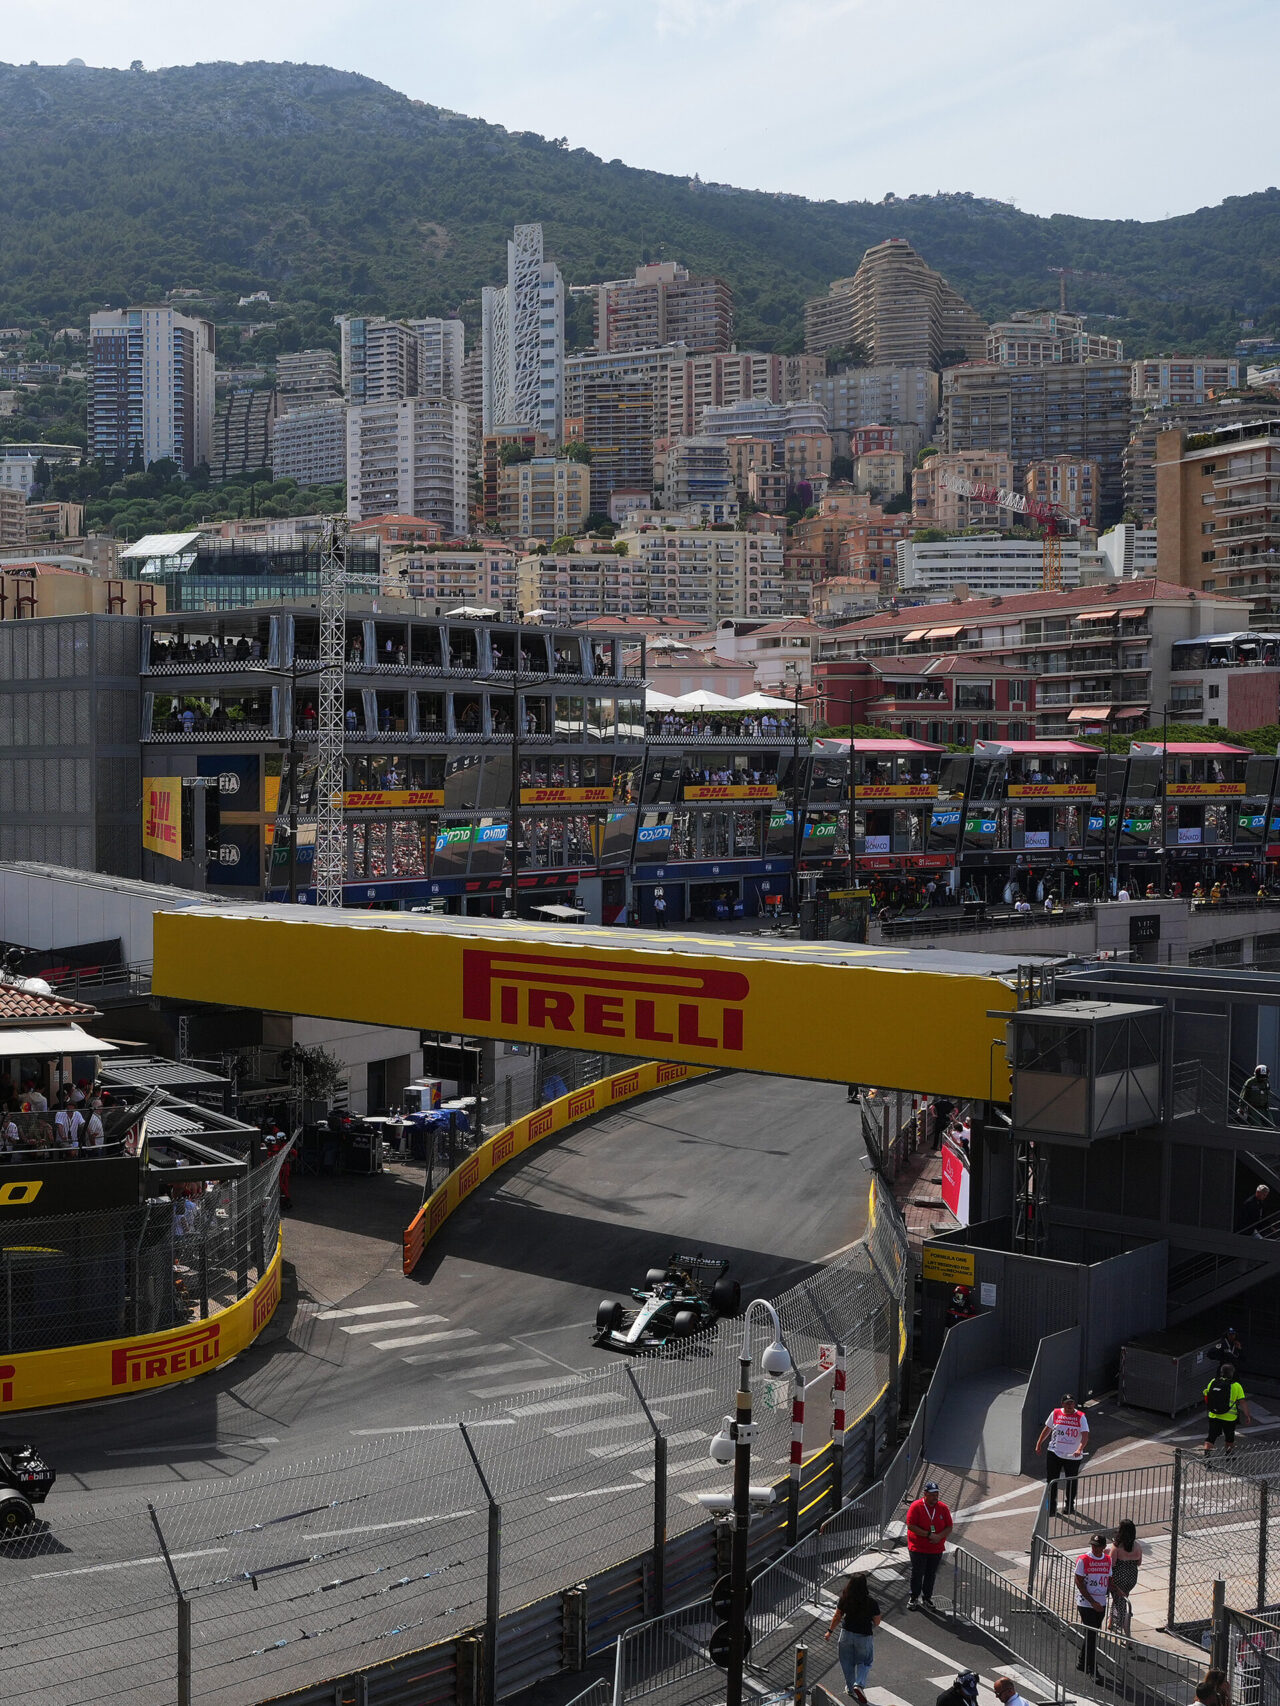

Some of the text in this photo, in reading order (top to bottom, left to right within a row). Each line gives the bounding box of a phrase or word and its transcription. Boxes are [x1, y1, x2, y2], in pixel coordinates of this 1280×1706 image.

[220, 776, 239, 790] FIA
[348, 793, 386, 805] DHL
[408, 792, 434, 804] DHL
[535, 790, 566, 800] DHL
[585, 789, 605, 800] DHL
[220, 847, 239, 862] FIA
[463, 948, 750, 1051] PIRELLI
[611, 1072, 639, 1100] PIRELLI
[568, 1088, 595, 1119] PIRELLI
[528, 1108, 553, 1141] PIRELLI
[492, 1130, 514, 1168] PIRELLI
[458, 1157, 479, 1198] PIRELLI
[430, 1188, 448, 1236] PIRELLI
[680, 1255, 721, 1265] PETRONAS
[252, 1266, 277, 1332] PIRELLI
[111, 1323, 220, 1386] PIRELLI
[1066, 1428, 1078, 1438] 410
[21, 1472, 43, 1481] Mobil
[1099, 1576, 1109, 1587] 40
